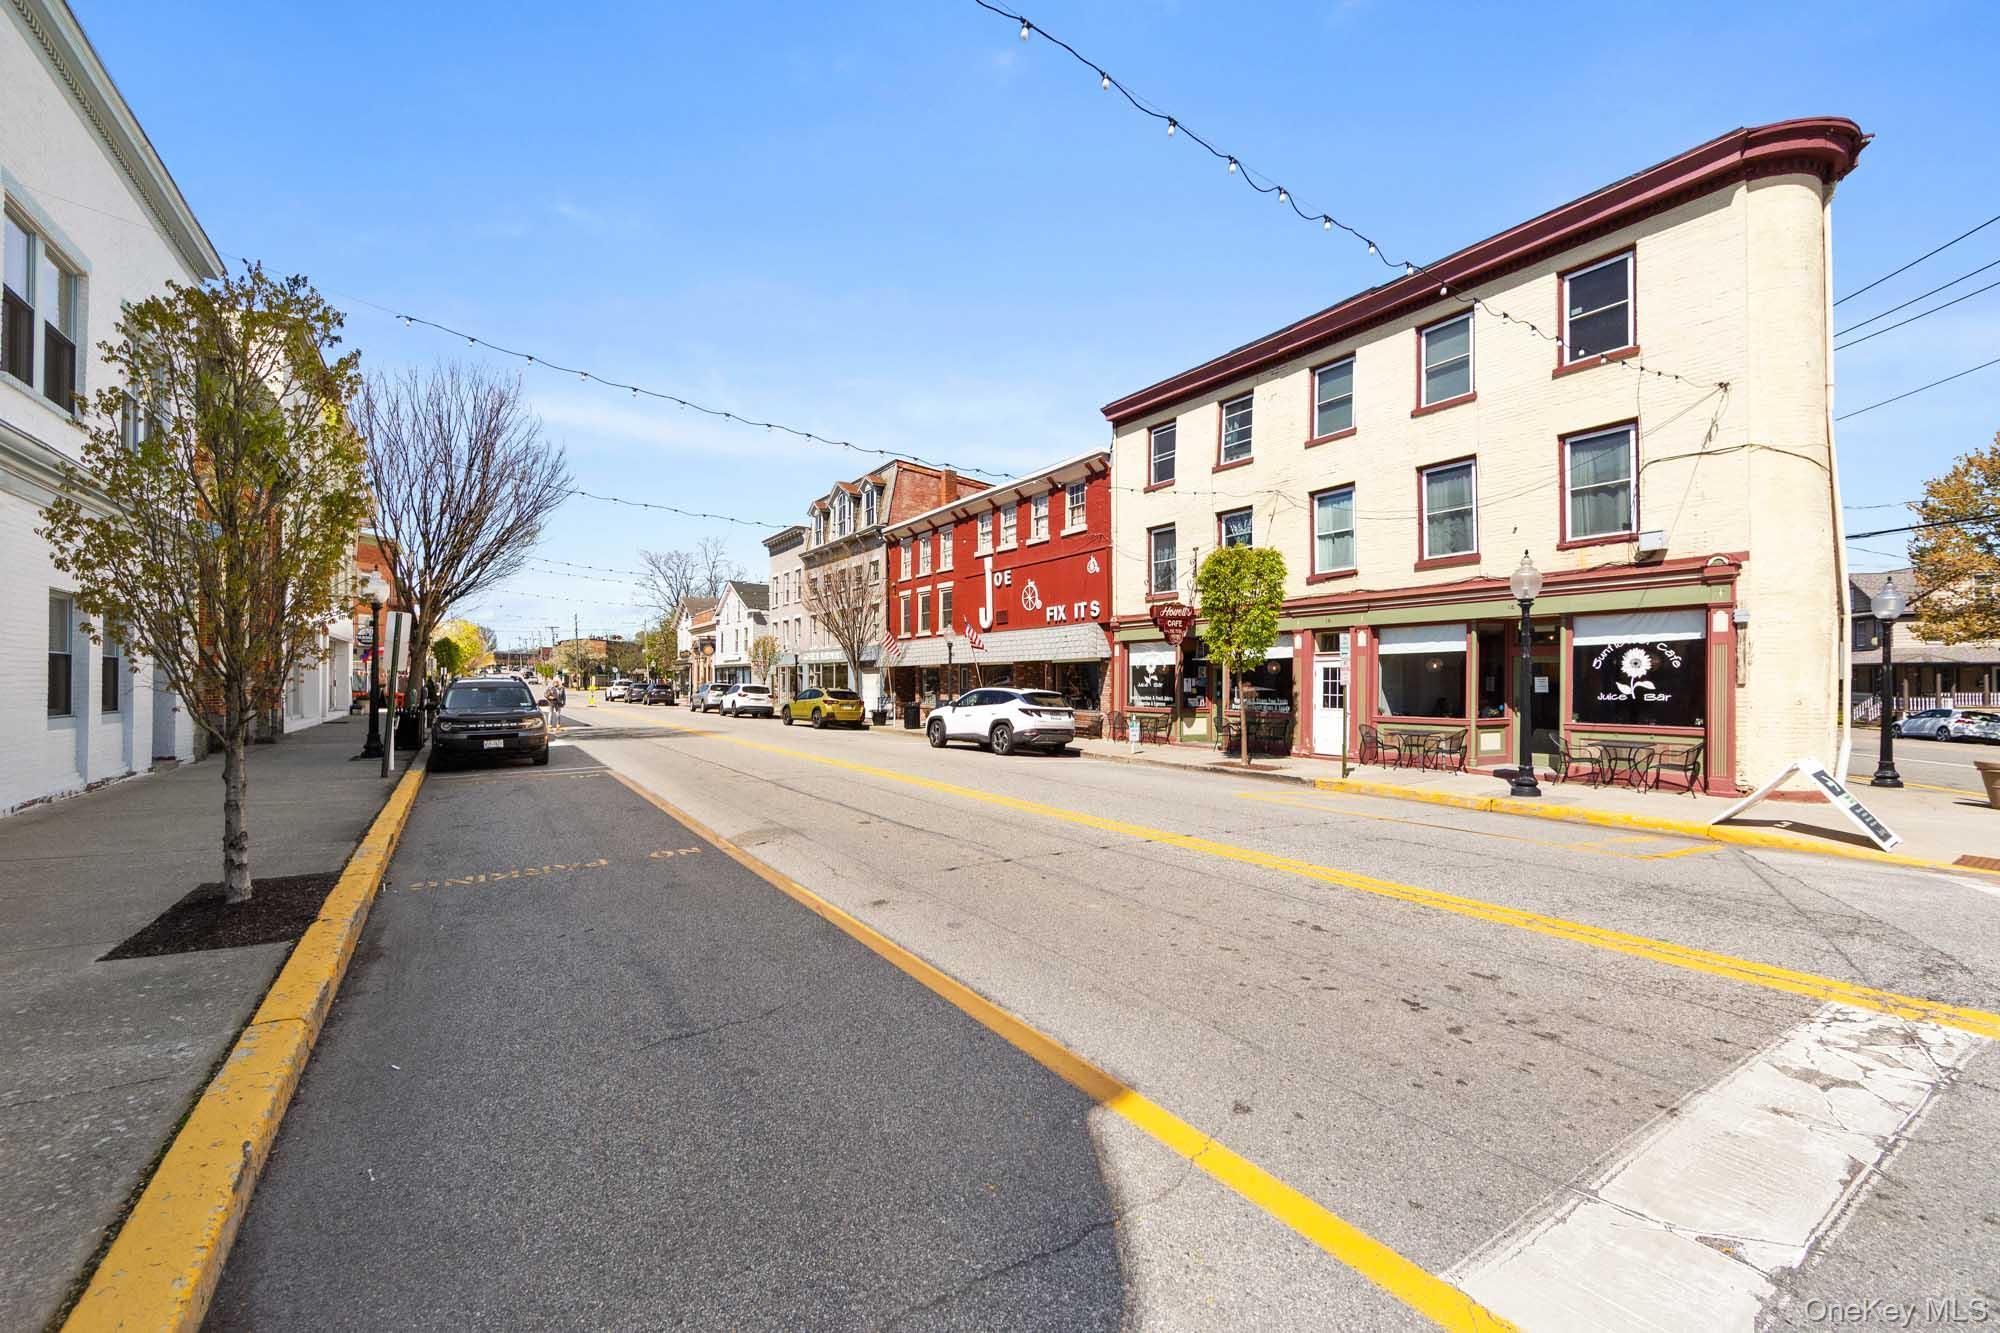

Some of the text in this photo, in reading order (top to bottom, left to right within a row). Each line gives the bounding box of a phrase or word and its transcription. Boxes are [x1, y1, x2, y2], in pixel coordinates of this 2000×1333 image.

[978, 556, 1012, 629] JOE
[1046, 604, 1067, 622] FIX
[1167, 619, 1183, 627] CAFE
[1597, 692, 1672, 702] Juice Bar
